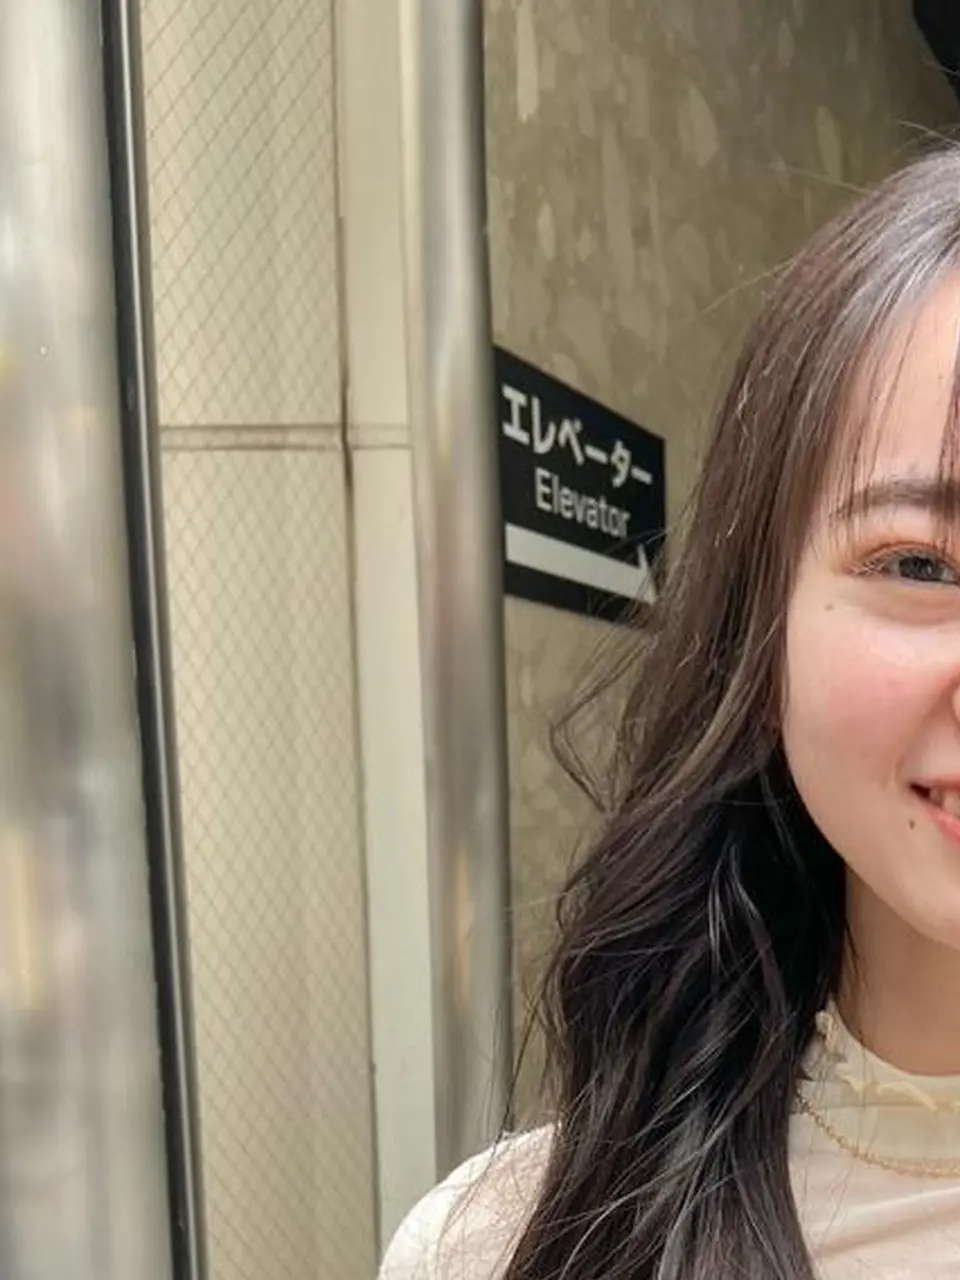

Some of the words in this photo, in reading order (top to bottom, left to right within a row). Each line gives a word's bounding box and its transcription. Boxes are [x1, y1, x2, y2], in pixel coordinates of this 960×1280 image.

[502, 383, 653, 488] エレベーター
[534, 466, 631, 539] Elevator
